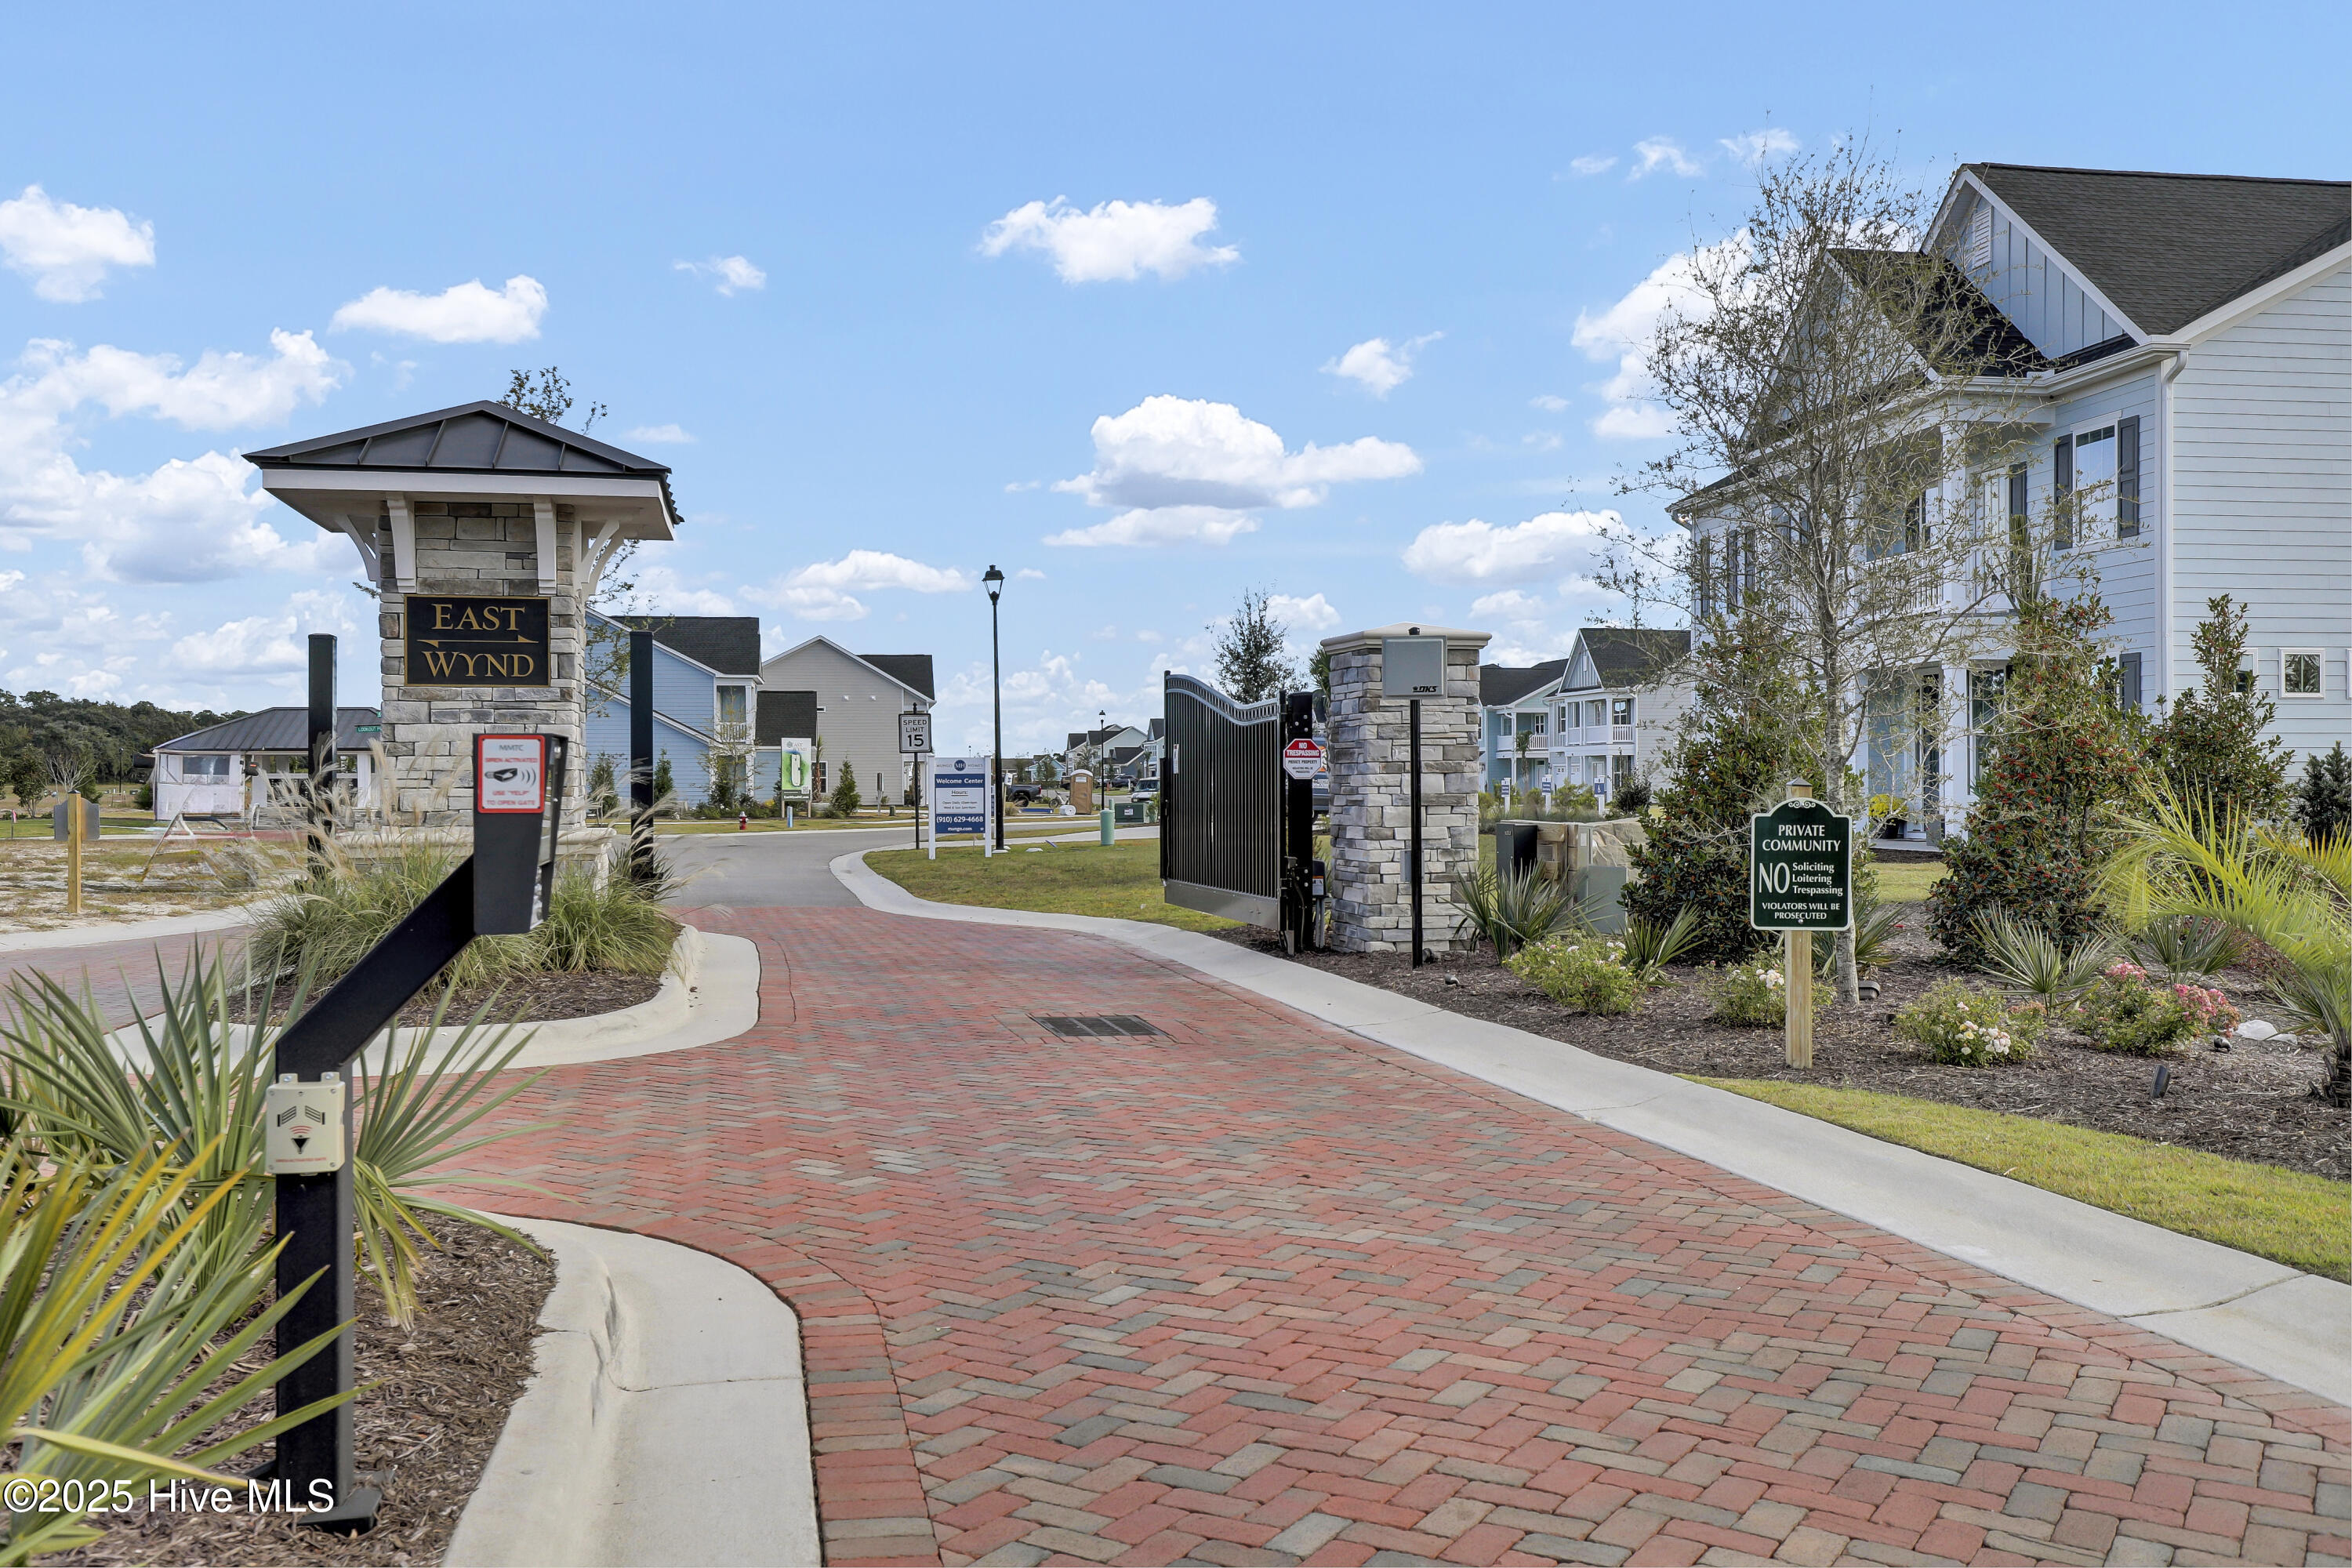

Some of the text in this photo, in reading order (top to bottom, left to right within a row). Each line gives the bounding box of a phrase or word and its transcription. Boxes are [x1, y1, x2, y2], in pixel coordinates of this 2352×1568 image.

[431, 604, 525, 630] EAST
[421, 651, 534, 677] WYND
[908, 735, 924, 746] 15
[1778, 824, 1825, 837] PRIVATE
[1762, 839, 1841, 851] COMMUNITY
[1792, 862, 1835, 873] Soliciting
[1759, 862, 1791, 894] NO
[1792, 873, 1832, 885] Loitering
[1792, 885, 1843, 897] Trespassing
